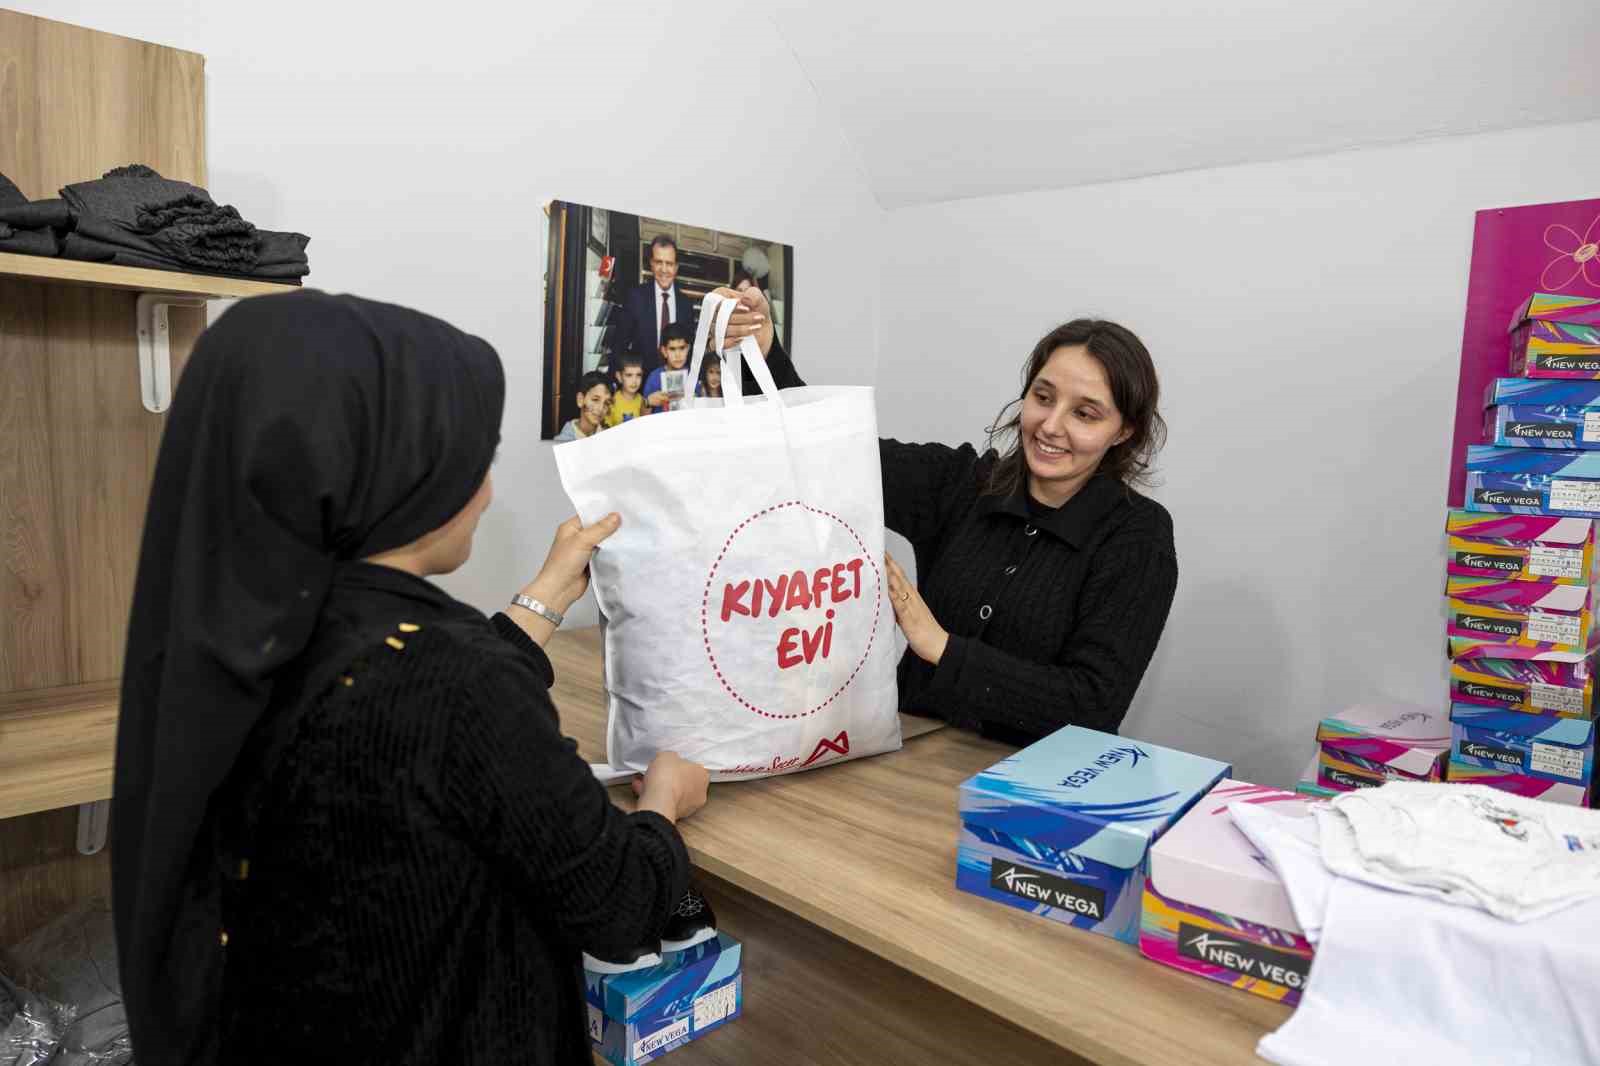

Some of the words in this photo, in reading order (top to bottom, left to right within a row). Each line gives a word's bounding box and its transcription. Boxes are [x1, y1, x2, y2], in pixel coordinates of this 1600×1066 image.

[1552, 361, 1576, 369] NEW
[1578, 361, 1600, 370] VEG
[1520, 428, 1544, 437] NEW
[1546, 430, 1573, 439] VEGA
[1489, 495, 1514, 504] NEW
[1514, 497, 1540, 506] VEGA
[1470, 559, 1493, 569] NEW
[1494, 562, 1520, 571] VEGA
[720, 558, 864, 622] KIYAFET
[1470, 621, 1491, 631] NEW
[1493, 624, 1519, 635] VEGA
[777, 608, 835, 669] EVİ
[1473, 688, 1494, 698] NEW
[1496, 692, 1522, 703] VEGA
[1095, 748, 1128, 769] NEW
[1474, 749, 1495, 759] NEW
[1496, 752, 1523, 765] VEGA
[1057, 767, 1104, 788] VEGA
[1015, 880, 1052, 901] NEW
[1055, 891, 1100, 918] VEGA
[1209, 947, 1255, 971] NEW
